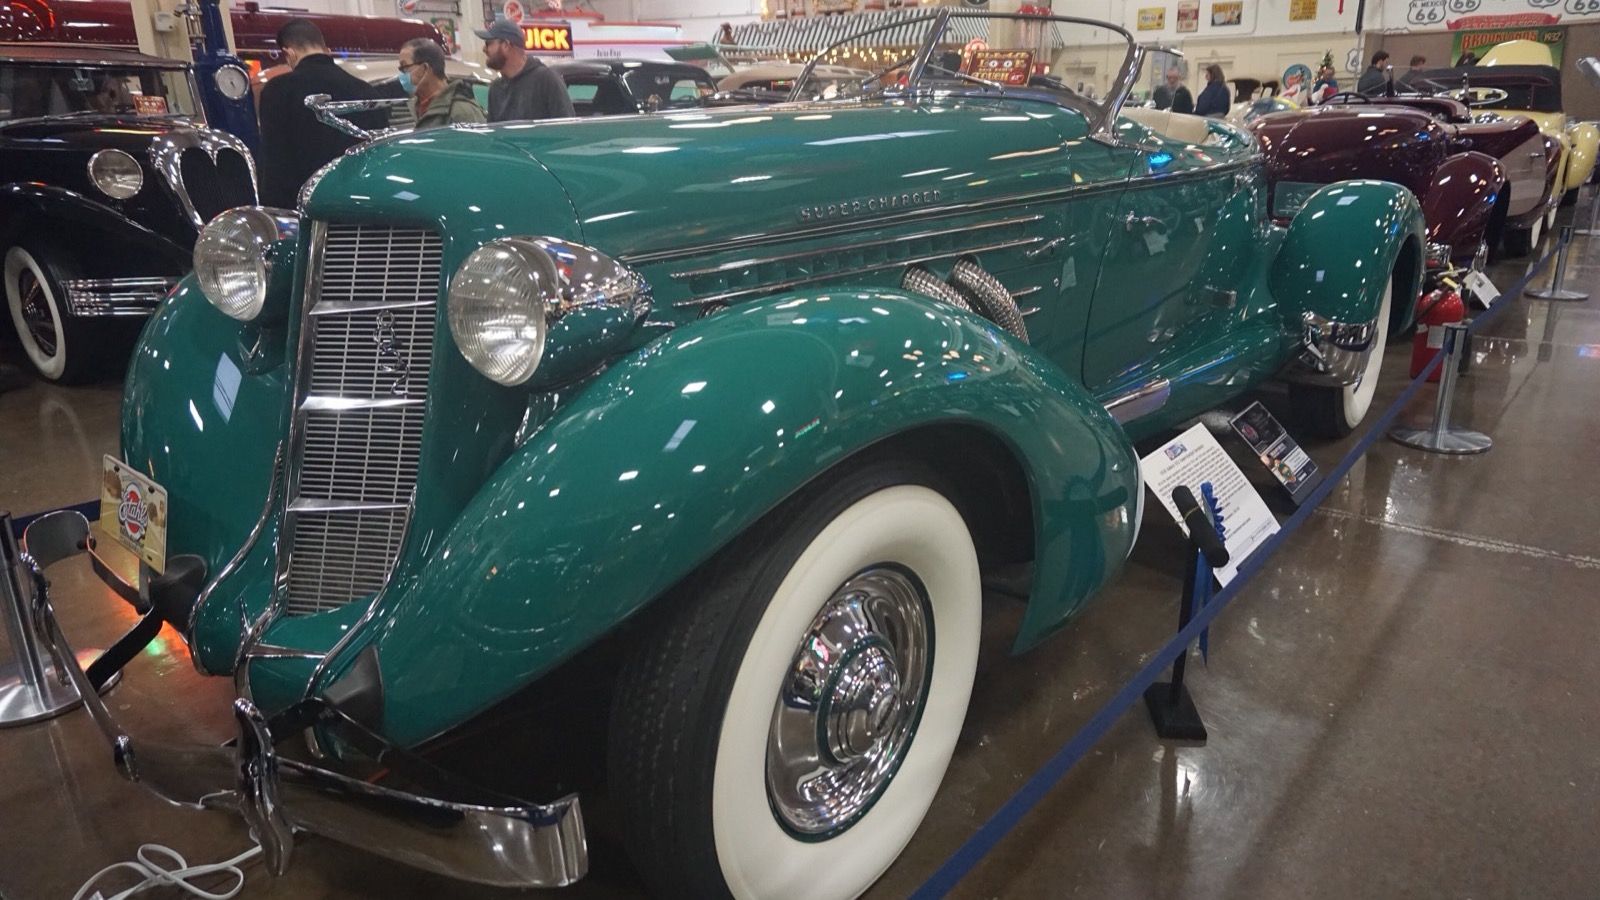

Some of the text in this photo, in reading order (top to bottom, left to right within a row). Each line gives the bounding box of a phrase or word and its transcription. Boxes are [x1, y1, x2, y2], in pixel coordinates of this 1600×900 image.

[1574, 0, 1599, 11] 66
[1415, 8, 1437, 21] 66
[522, 28, 570, 50] UICK
